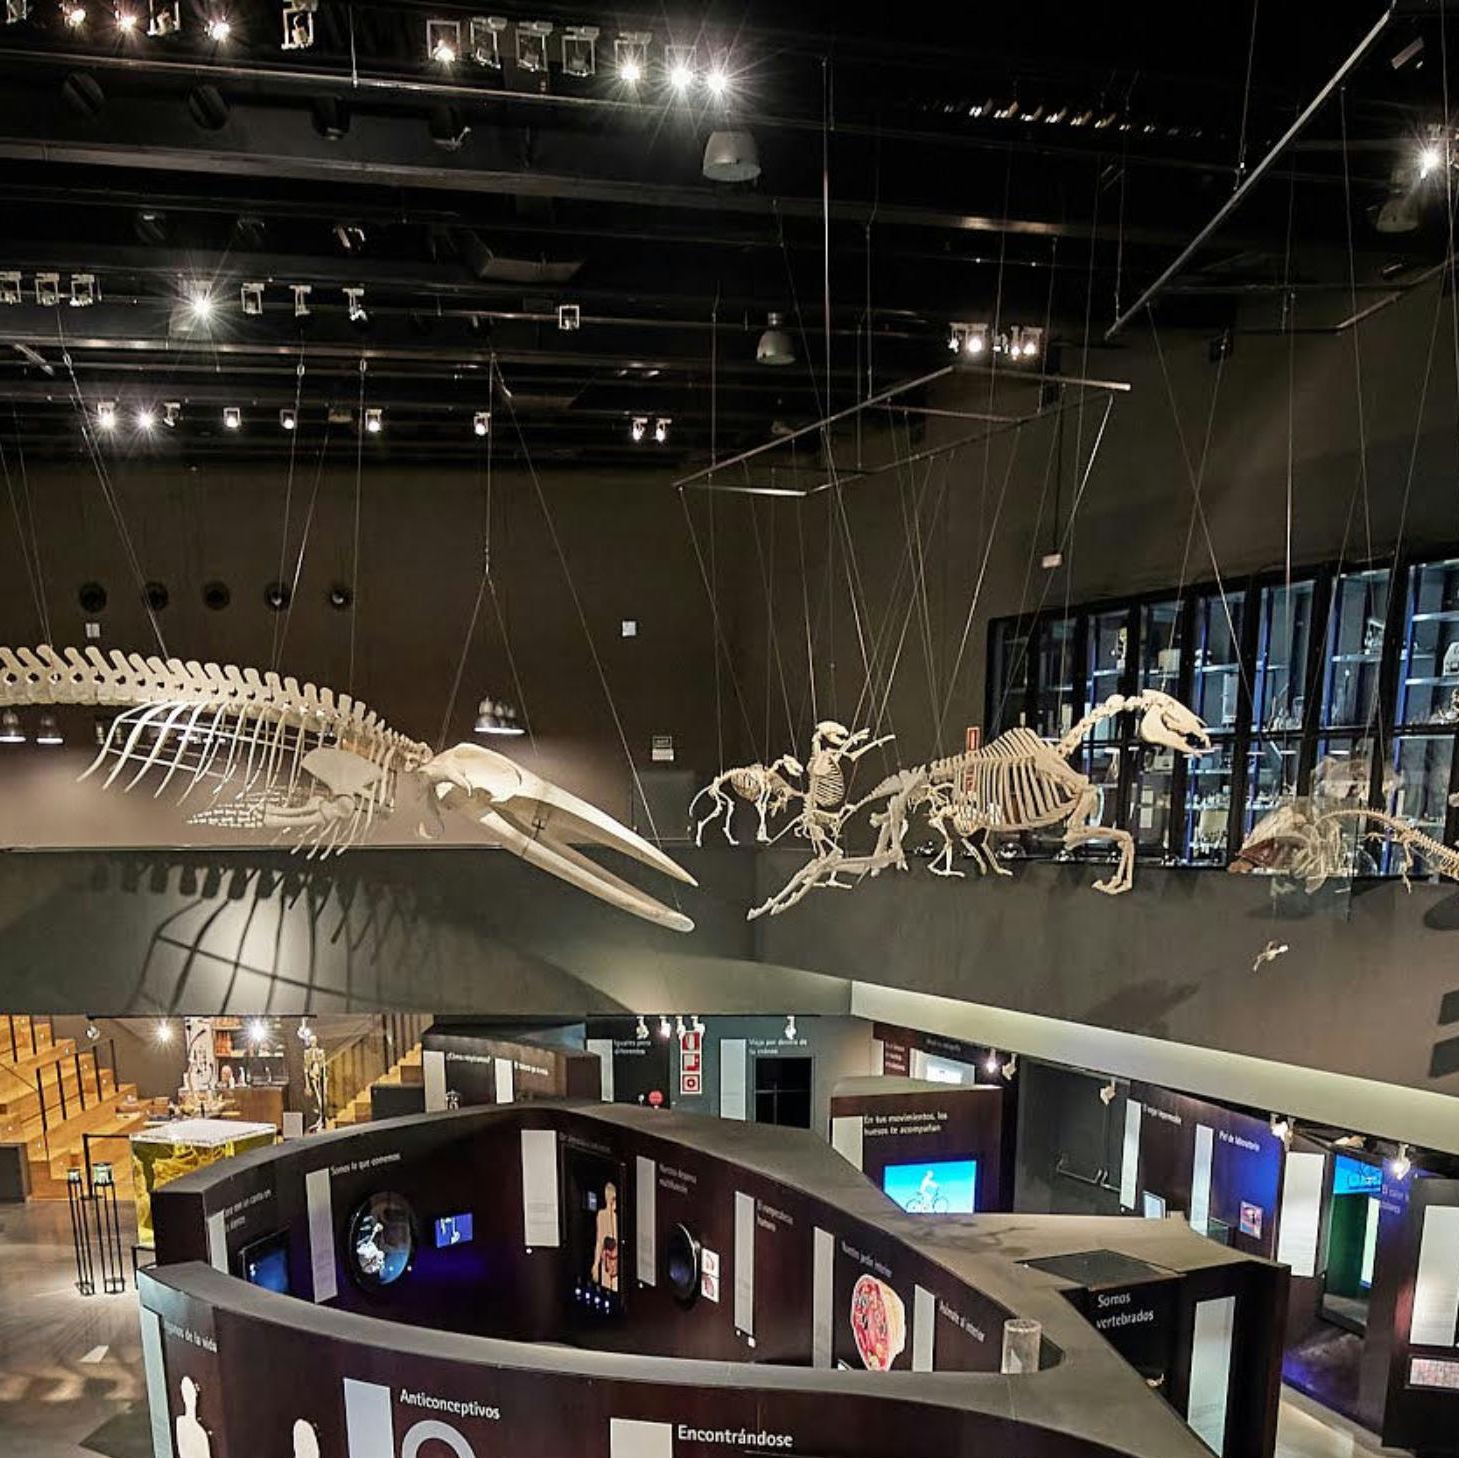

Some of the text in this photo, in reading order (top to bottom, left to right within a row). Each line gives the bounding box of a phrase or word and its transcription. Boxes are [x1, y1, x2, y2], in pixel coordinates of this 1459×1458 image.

[1097, 1292, 1131, 1308] Somos
[1096, 1308, 1154, 1329] vertebrados
[400, 1388, 500, 1419] Anticonceptivos
[677, 1424, 793, 1454] Encontrándose
